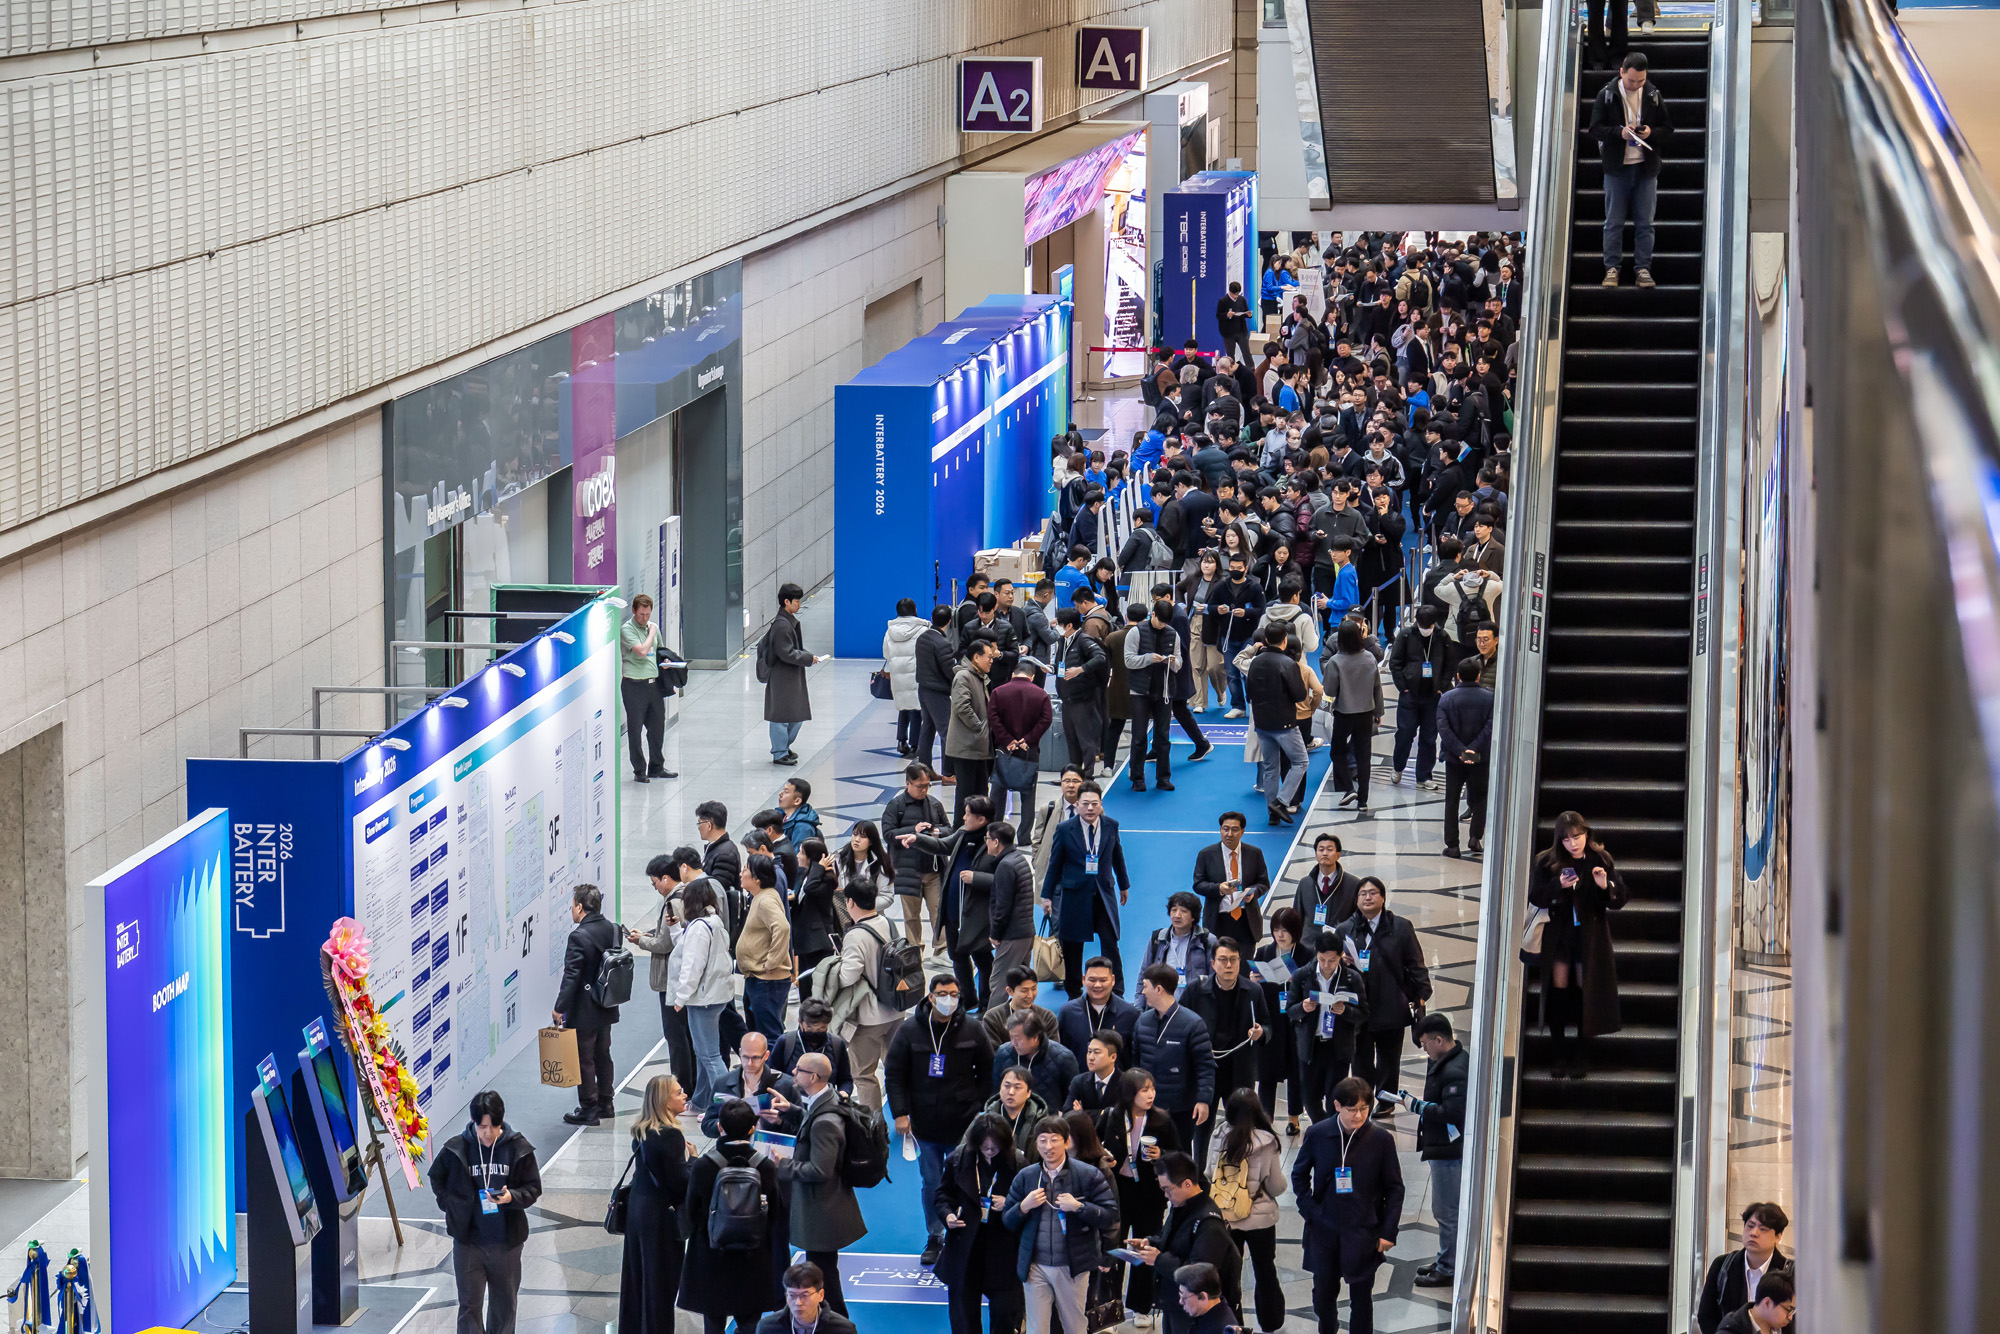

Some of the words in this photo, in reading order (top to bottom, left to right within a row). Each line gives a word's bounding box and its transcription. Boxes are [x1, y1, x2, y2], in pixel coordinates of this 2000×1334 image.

[1085, 37, 1136, 82] A1
[966, 71, 1030, 122] A2
[875, 413, 886, 487] INTERBATTERY
[583, 456, 616, 518] coex
[875, 489, 886, 516] 2026
[383, 755, 397, 778] 2026
[257, 823, 277, 883] INTER
[279, 823, 293, 860] 2026
[549, 814, 560, 856] 3F
[234, 823, 254, 908] BATTERY
[456, 913, 468, 958] 1F
[522, 914, 533, 959] 2F
[153, 981, 175, 1013] BOOTH
[175, 971, 190, 997] MAP
